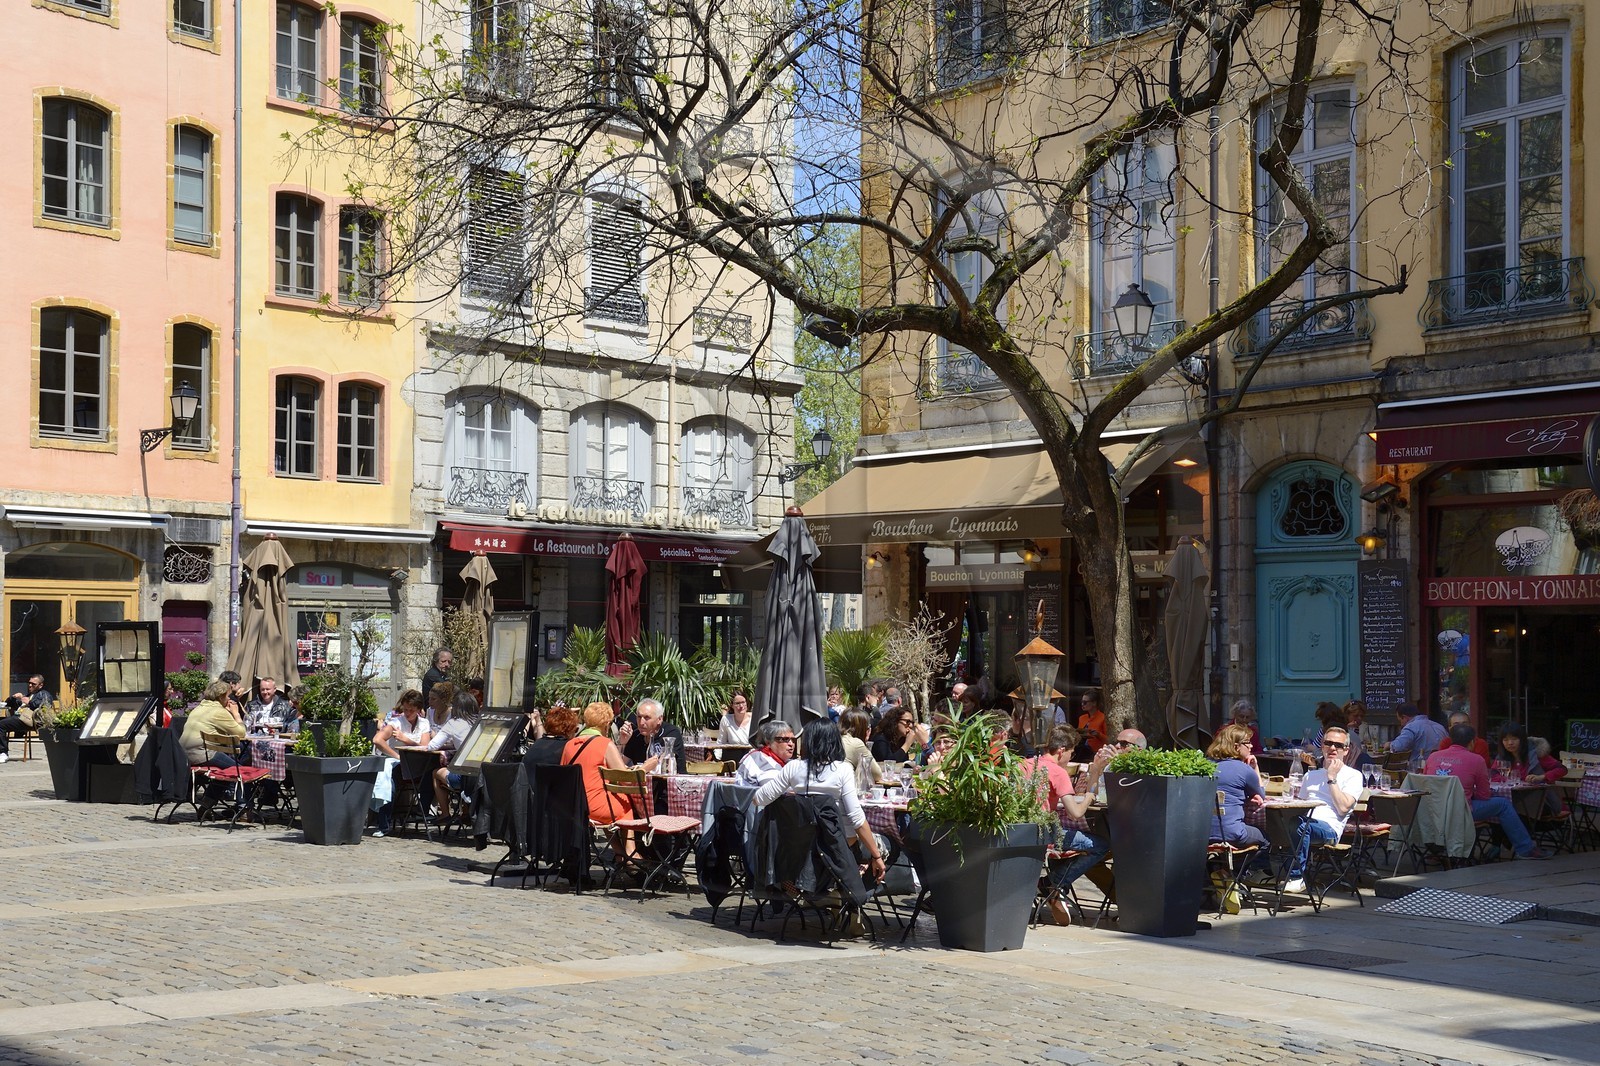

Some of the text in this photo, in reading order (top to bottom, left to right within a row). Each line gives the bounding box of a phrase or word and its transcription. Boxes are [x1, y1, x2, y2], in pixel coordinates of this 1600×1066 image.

[1389, 445, 1433, 458] RESTAURANT
[537, 502, 634, 526] restaurant
[871, 516, 1019, 538] Bouchon Lyonnais
[533, 539, 544, 552] Le
[548, 539, 595, 555] Restaurant
[597, 543, 610, 556] De
[659, 547, 691, 558] Spécialités
[930, 567, 1025, 582] Bouchon Lyonnais
[1428, 579, 1600, 600] BOUCHON LYONNAIS
